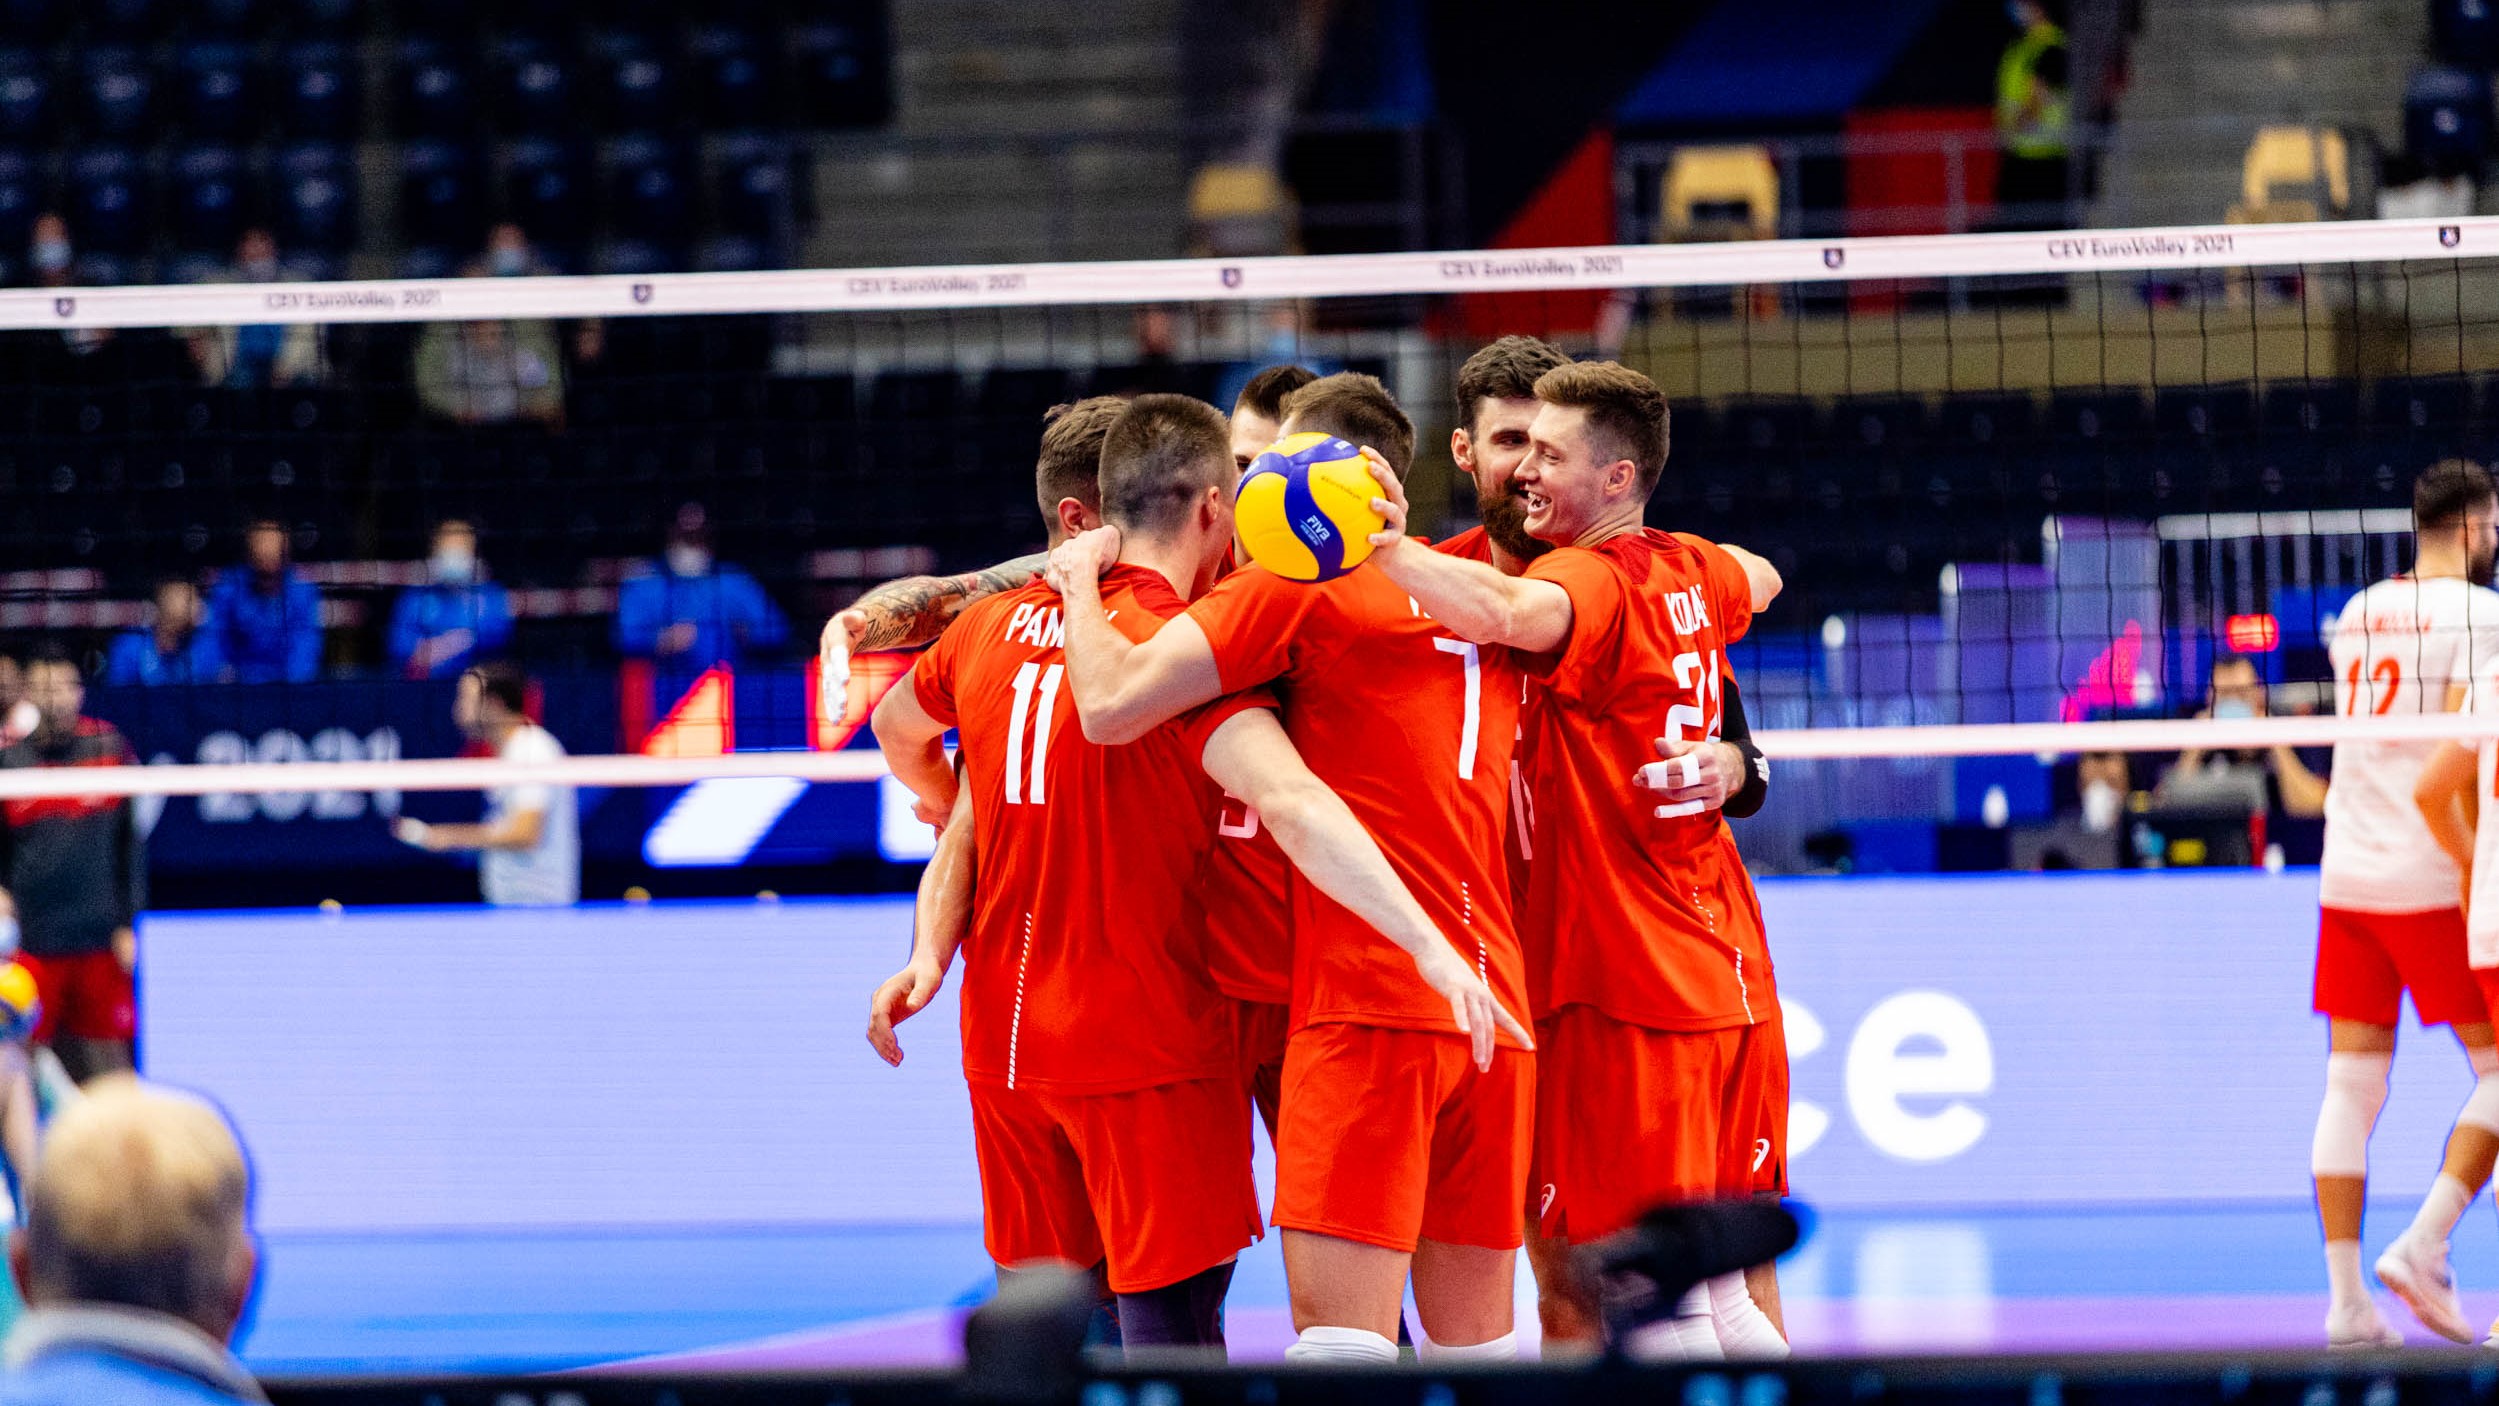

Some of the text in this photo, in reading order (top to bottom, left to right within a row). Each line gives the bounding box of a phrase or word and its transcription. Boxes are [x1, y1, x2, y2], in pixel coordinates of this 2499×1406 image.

[2048, 233, 2234, 260] CEV EuroVolley 2021
[1440, 254, 1624, 280] CEV EuroVolley 2021
[1307, 515, 1330, 541] FIVB
[1432, 636, 1481, 780] 7
[1005, 661, 1065, 805] 11
